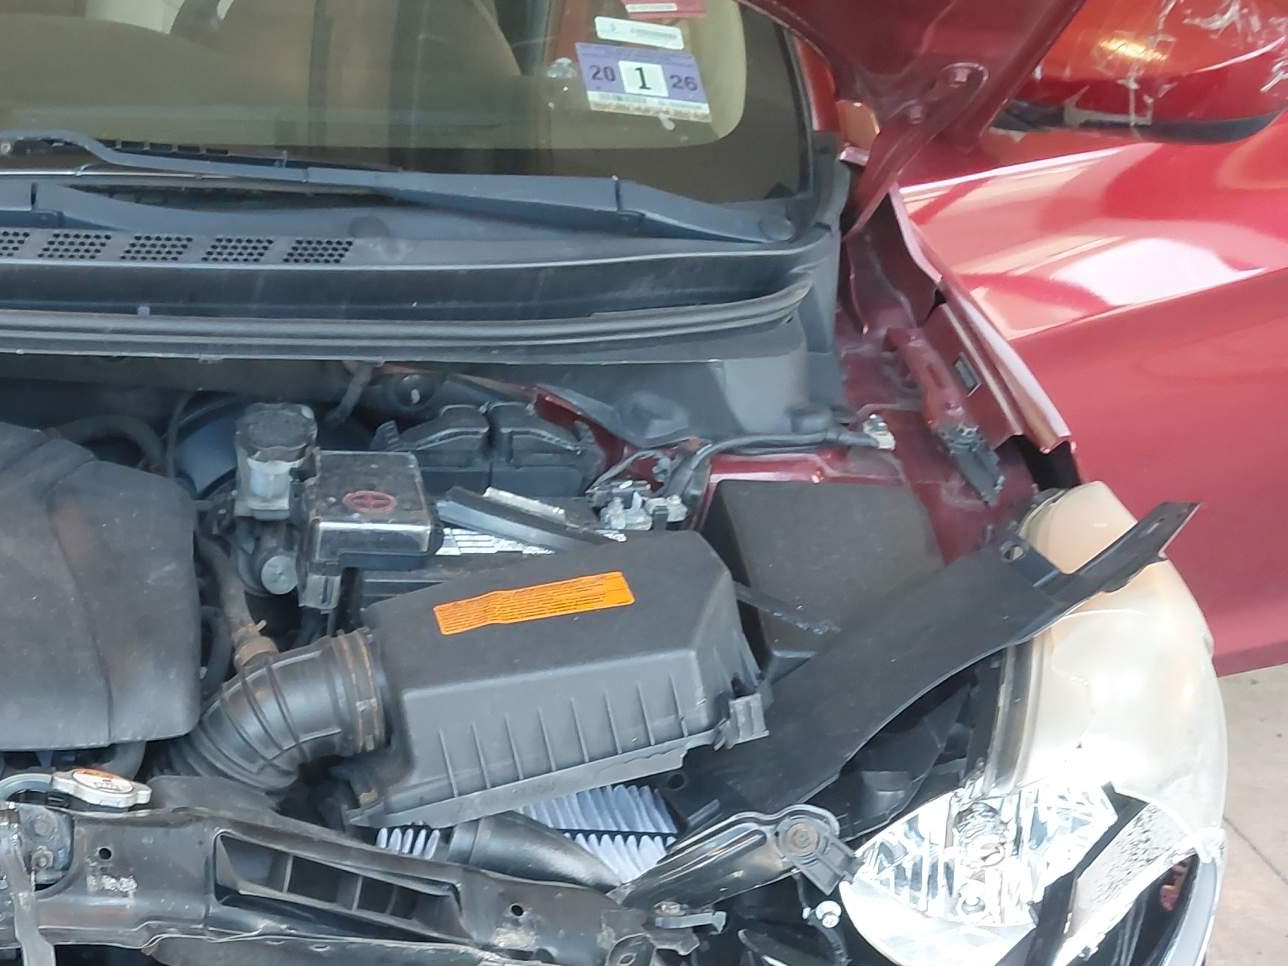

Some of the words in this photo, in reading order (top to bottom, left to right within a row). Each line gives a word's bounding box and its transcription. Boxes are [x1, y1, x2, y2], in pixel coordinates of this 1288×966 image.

[590, 65, 616, 82] 20
[634, 66, 651, 91] 1
[669, 73, 698, 92] 26
